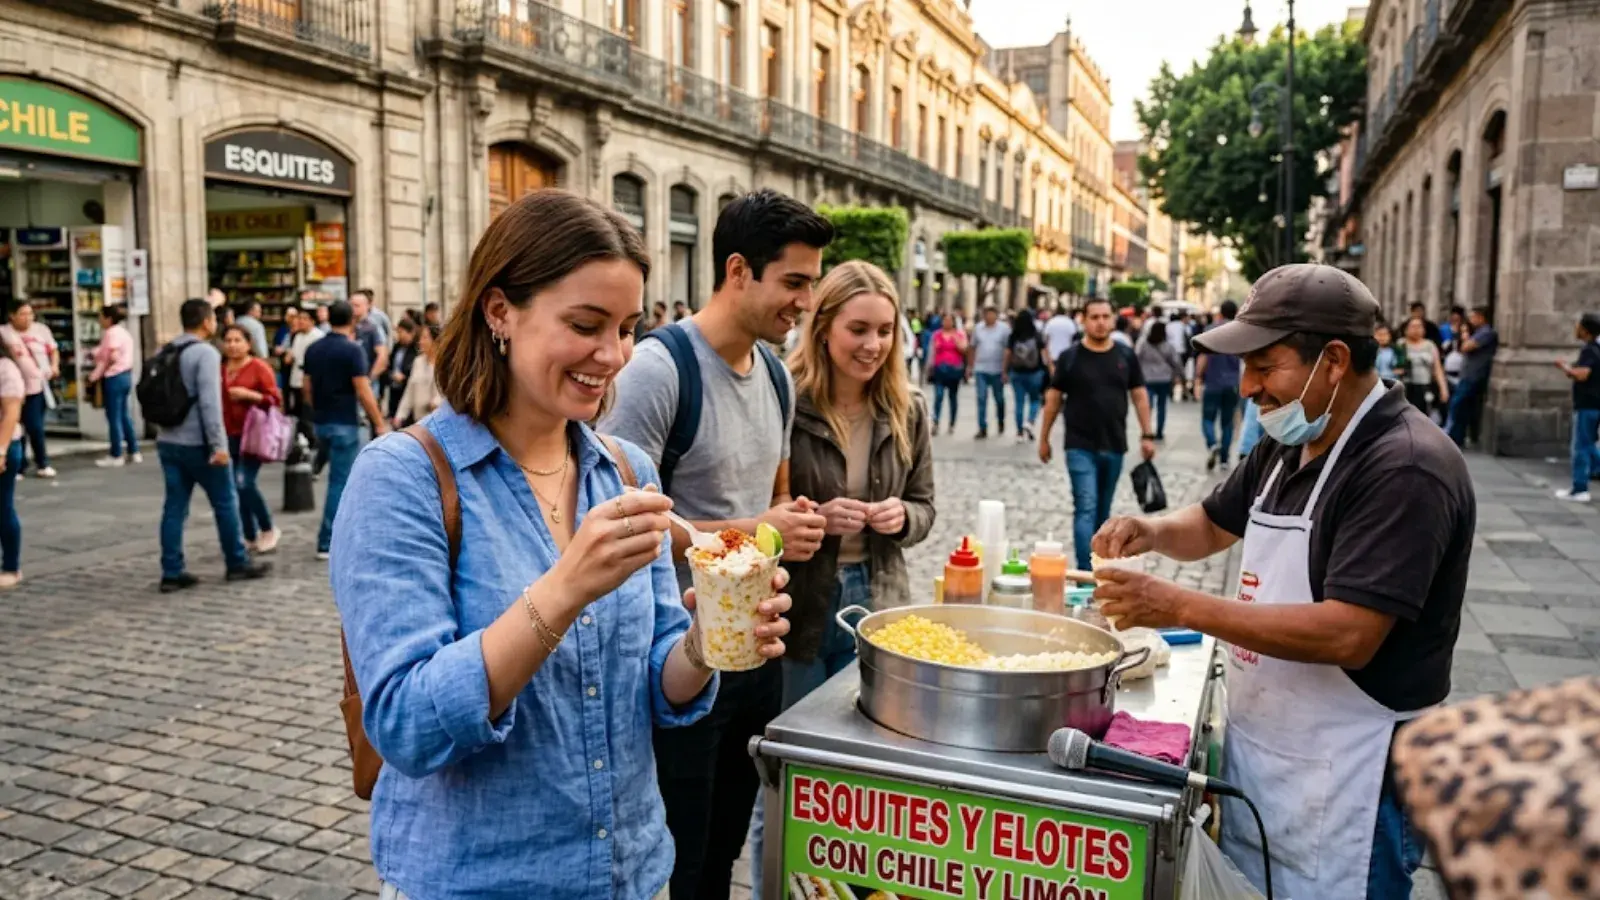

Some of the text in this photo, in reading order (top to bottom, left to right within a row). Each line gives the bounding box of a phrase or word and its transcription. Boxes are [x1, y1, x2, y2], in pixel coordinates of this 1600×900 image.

[225, 144, 335, 184] ESQUITES
[793, 775, 1131, 880] ESQUITES Y ELOTES
[808, 834, 867, 876] CON
[876, 848, 964, 896] CHILE
[972, 866, 995, 900] Y
